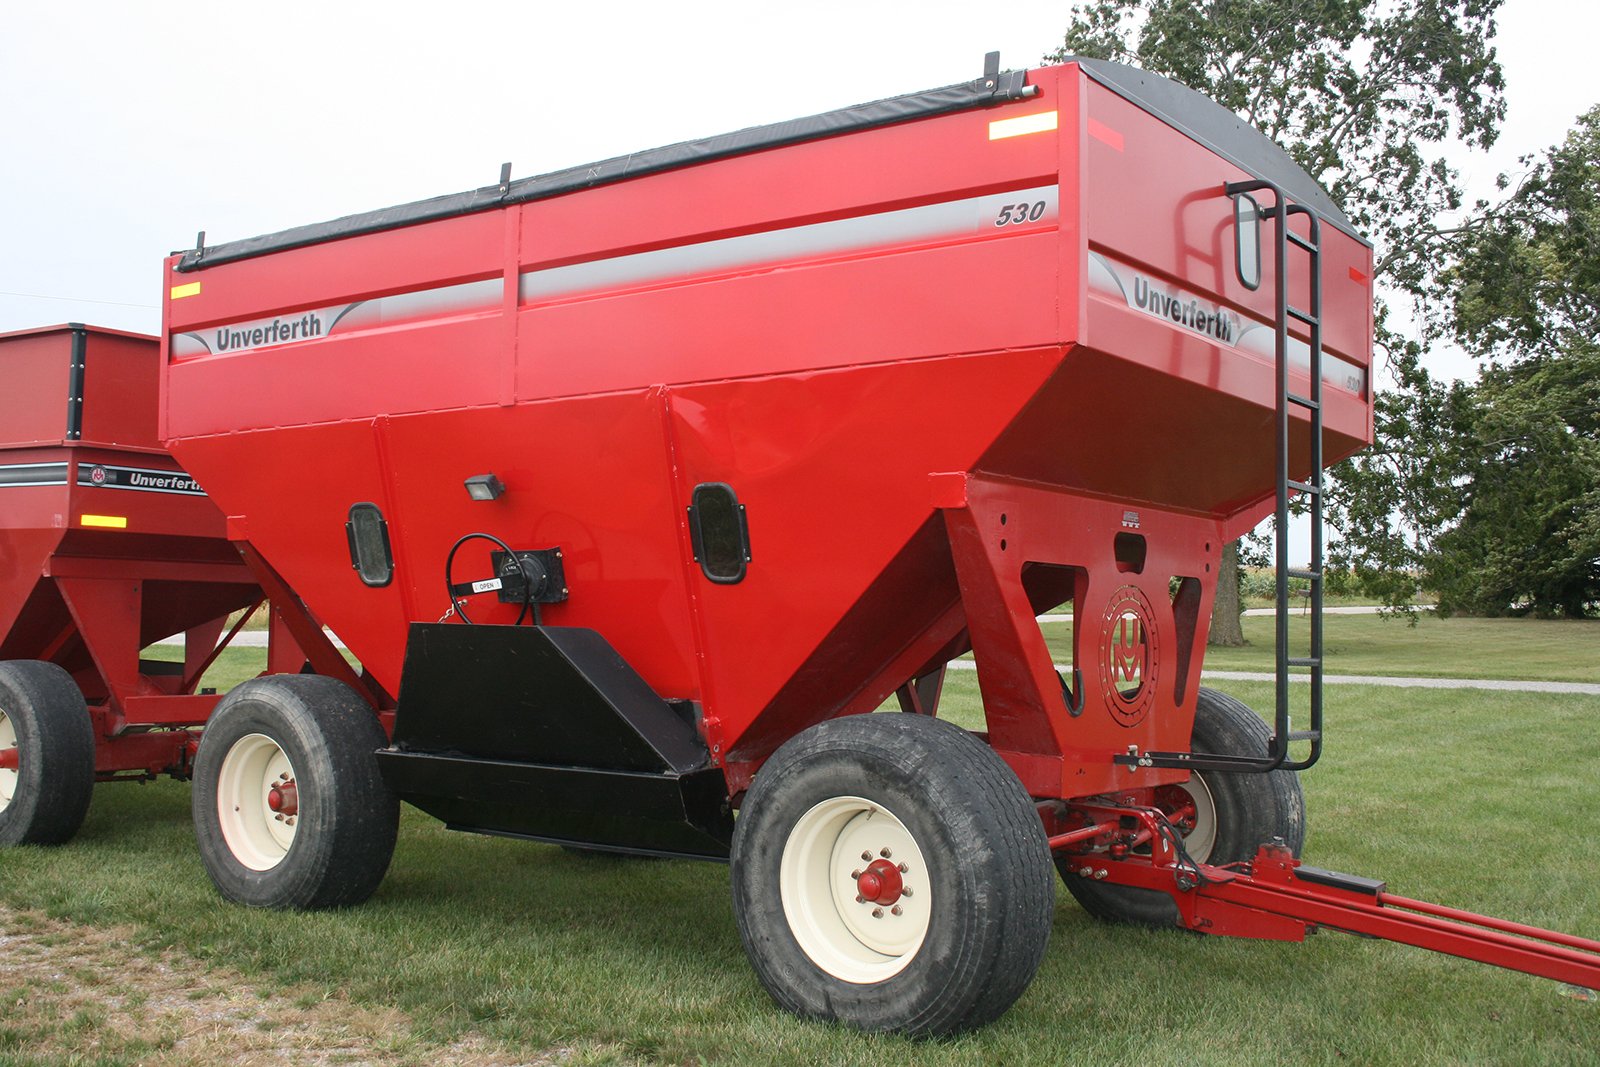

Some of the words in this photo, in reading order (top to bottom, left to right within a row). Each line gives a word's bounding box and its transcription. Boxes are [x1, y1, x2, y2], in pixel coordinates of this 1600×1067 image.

[995, 200, 1047, 227] 530
[1134, 276, 1231, 342] Unverferth
[216, 313, 321, 351] Unverferth
[479, 582, 495, 590] OPEN
